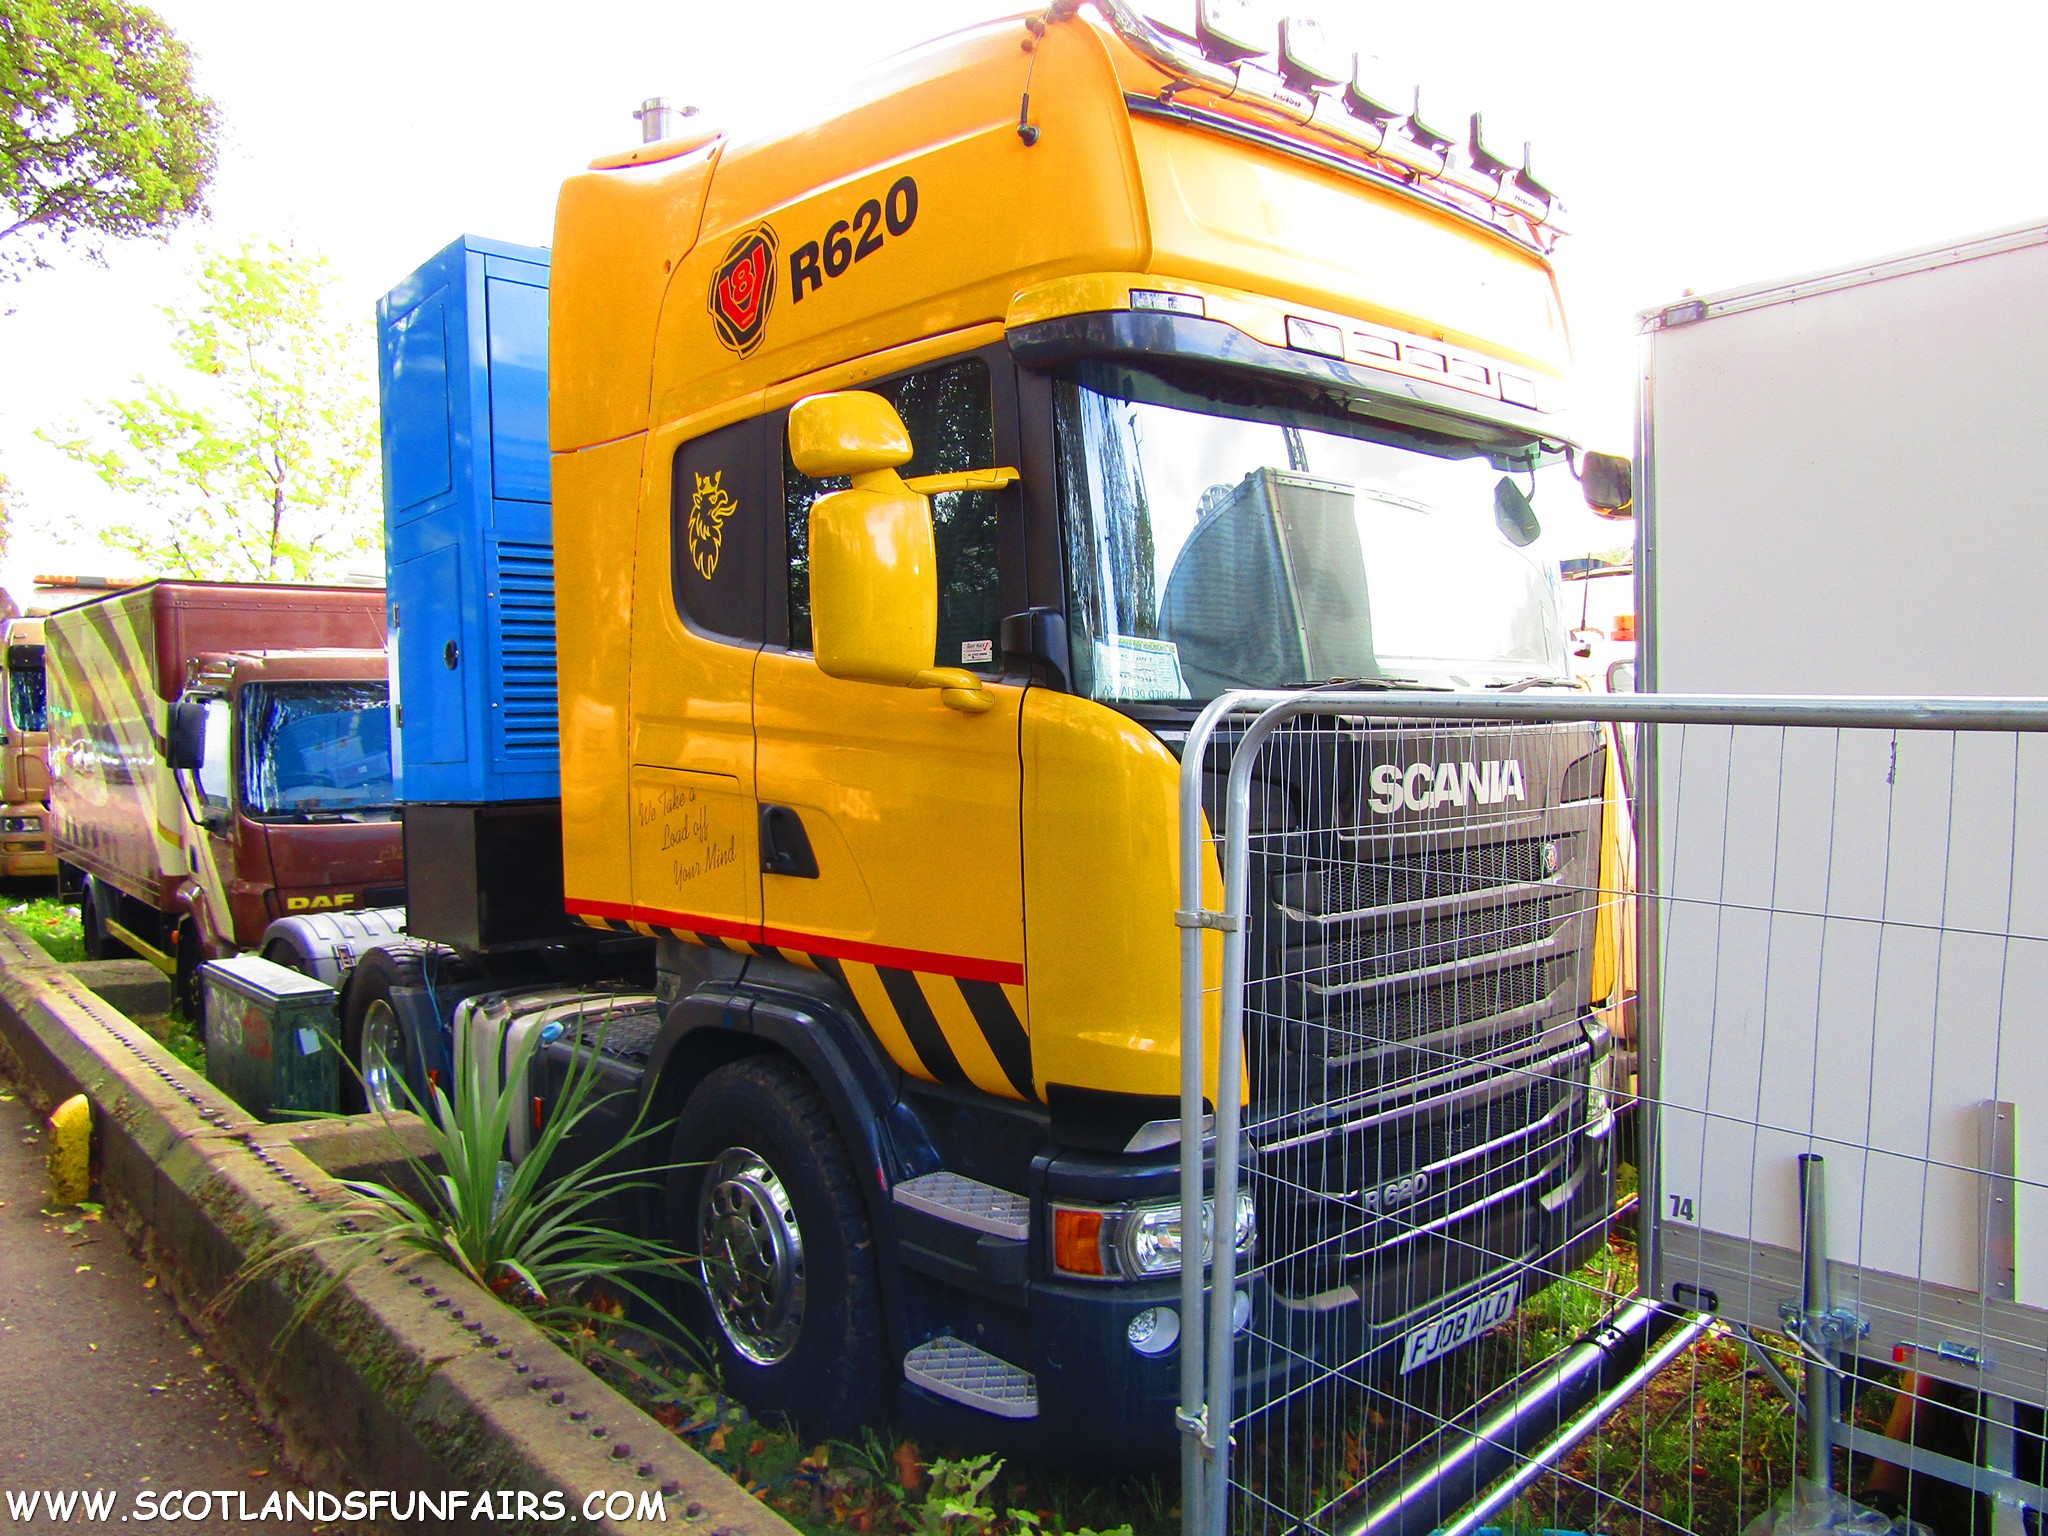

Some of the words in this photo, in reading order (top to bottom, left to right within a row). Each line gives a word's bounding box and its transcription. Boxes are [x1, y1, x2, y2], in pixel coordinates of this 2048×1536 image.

[789, 176, 918, 305] R620
[640, 801, 656, 827] We
[658, 785, 685, 816] Take
[689, 787, 697, 802] a
[1368, 759, 1525, 813] SCANIA
[661, 813, 690, 851] Load
[693, 804, 708, 843] off
[673, 860, 701, 892] Your
[705, 834, 736, 873] Mind
[287, 893, 354, 910] DAF
[1669, 1194, 1694, 1220] 74
